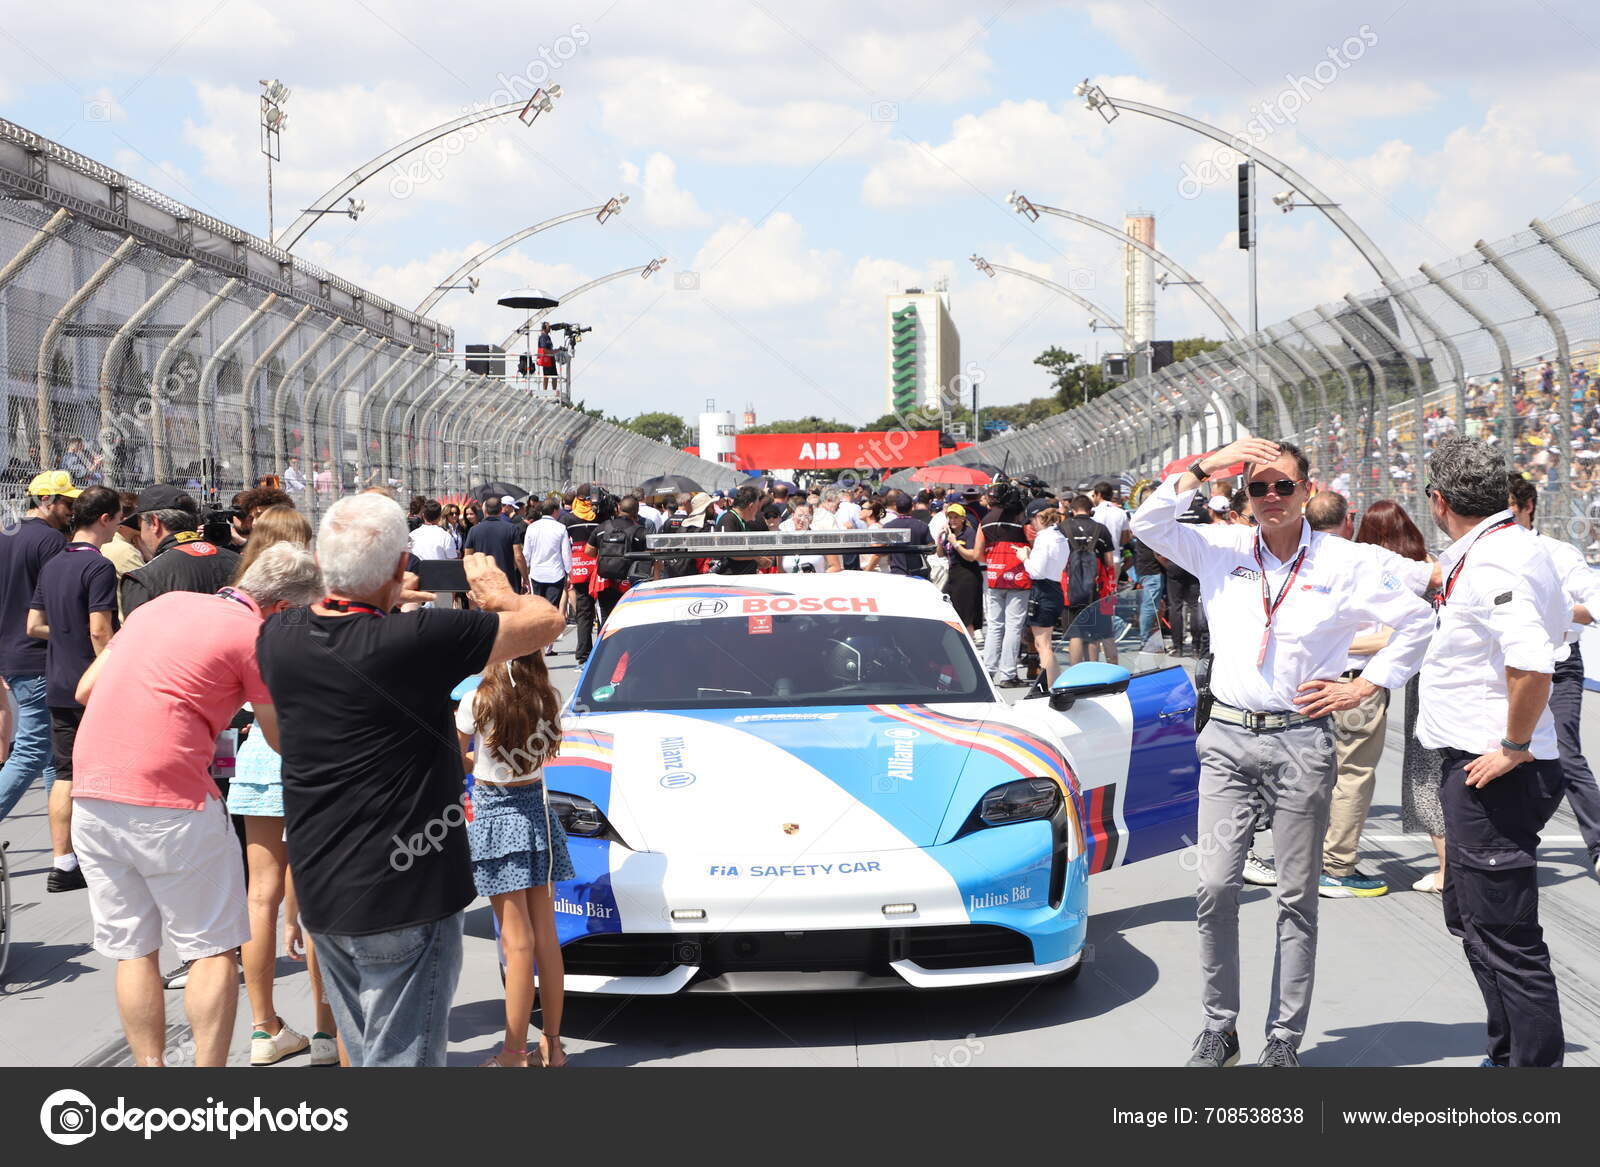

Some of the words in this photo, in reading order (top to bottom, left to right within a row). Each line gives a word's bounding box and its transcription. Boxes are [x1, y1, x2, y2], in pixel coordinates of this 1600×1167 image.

[799, 442, 841, 460] ABB
[743, 597, 879, 613] BOSCH
[660, 736, 686, 770] Allianz
[888, 740, 913, 781] Allianz
[750, 864, 833, 877] SAFETY
[838, 861, 881, 874] CAR
[554, 898, 583, 916] ulius
[586, 902, 613, 919] Bär
[969, 892, 1009, 913] Julius
[1012, 885, 1032, 902] Bär
